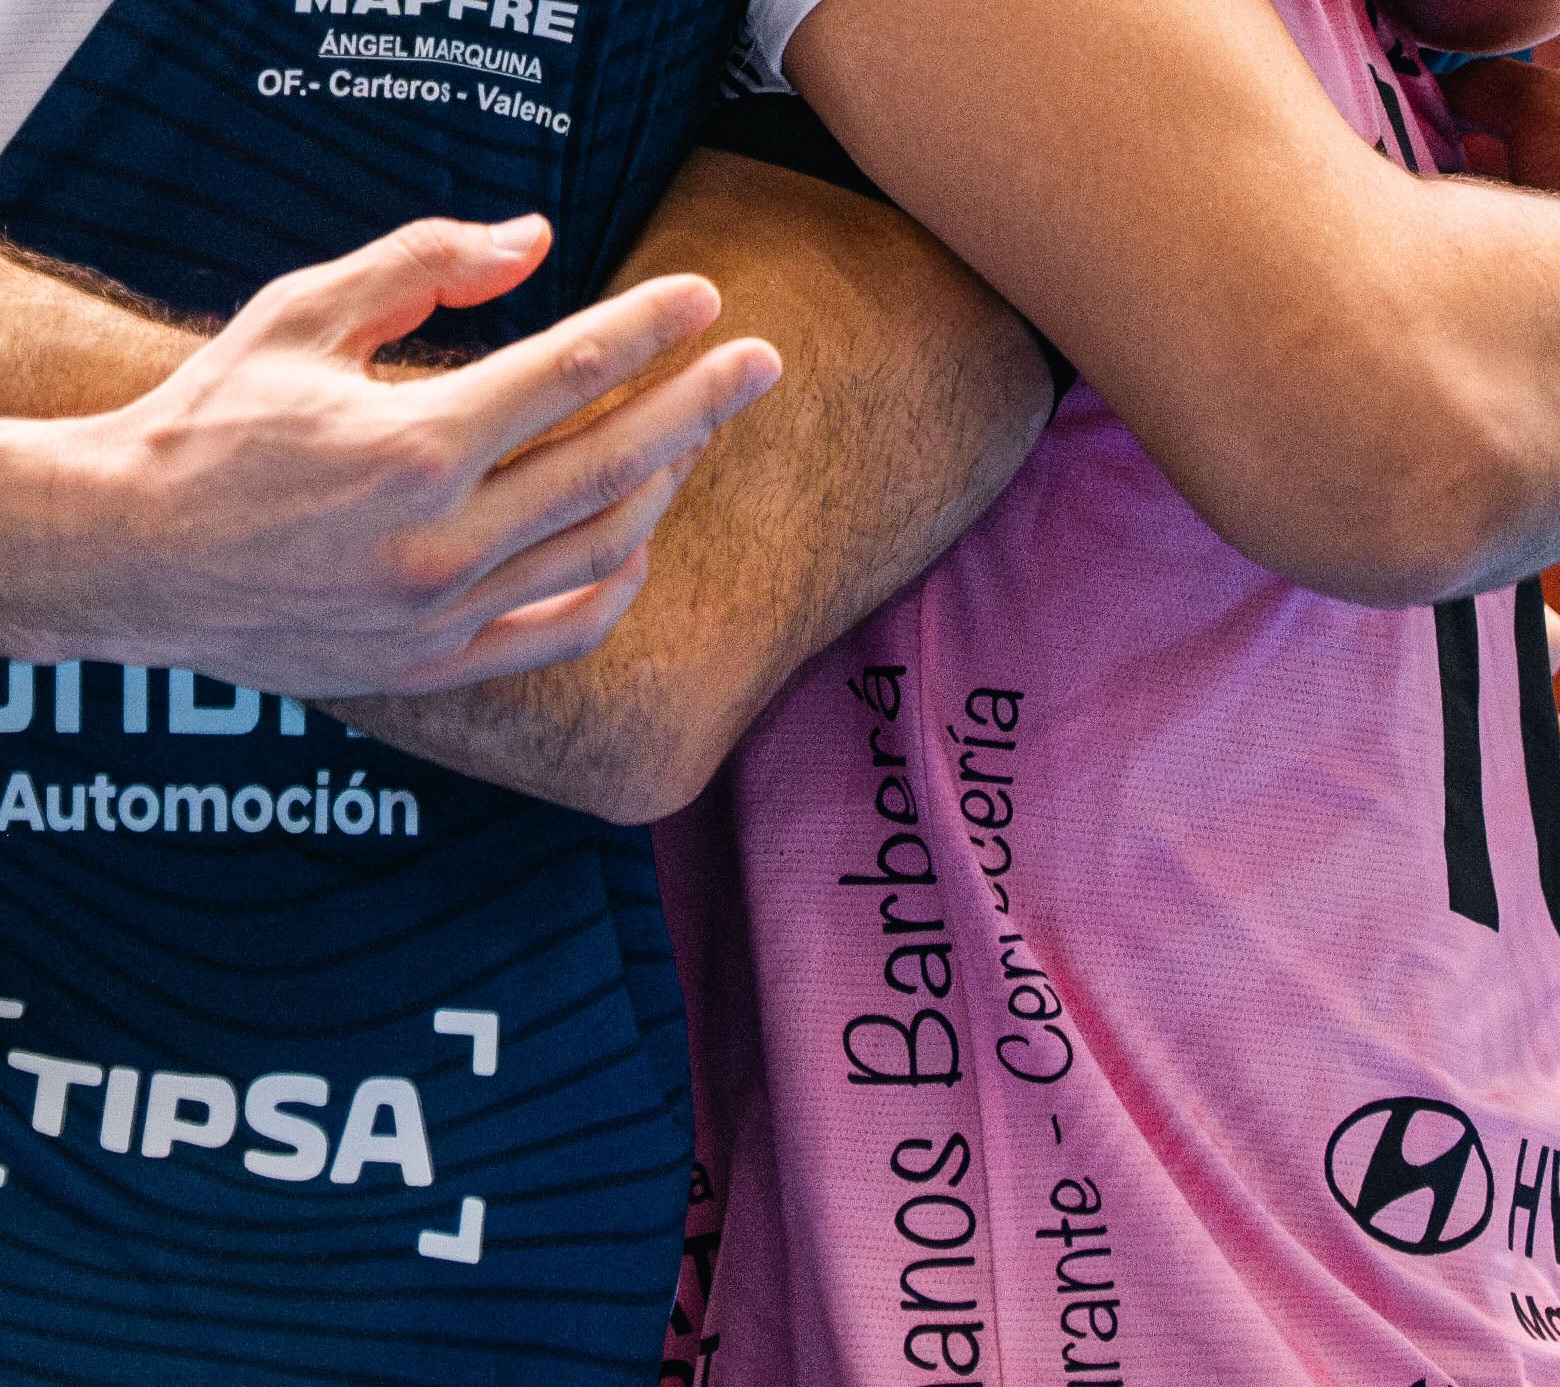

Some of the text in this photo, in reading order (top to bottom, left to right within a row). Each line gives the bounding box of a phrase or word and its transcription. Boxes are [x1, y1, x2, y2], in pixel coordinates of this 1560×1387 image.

[318, 27, 544, 80] ÁNGEL MARQUINA
[329, 69, 451, 103] Carteros
[476, 81, 572, 136] Valenc
[947, 686, 1075, 1085] Cercería
[838, 664, 985, 1387] anos Barberá
[7, 1049, 435, 1189] TIPSA
[1035, 1176, 1125, 1387] rante
